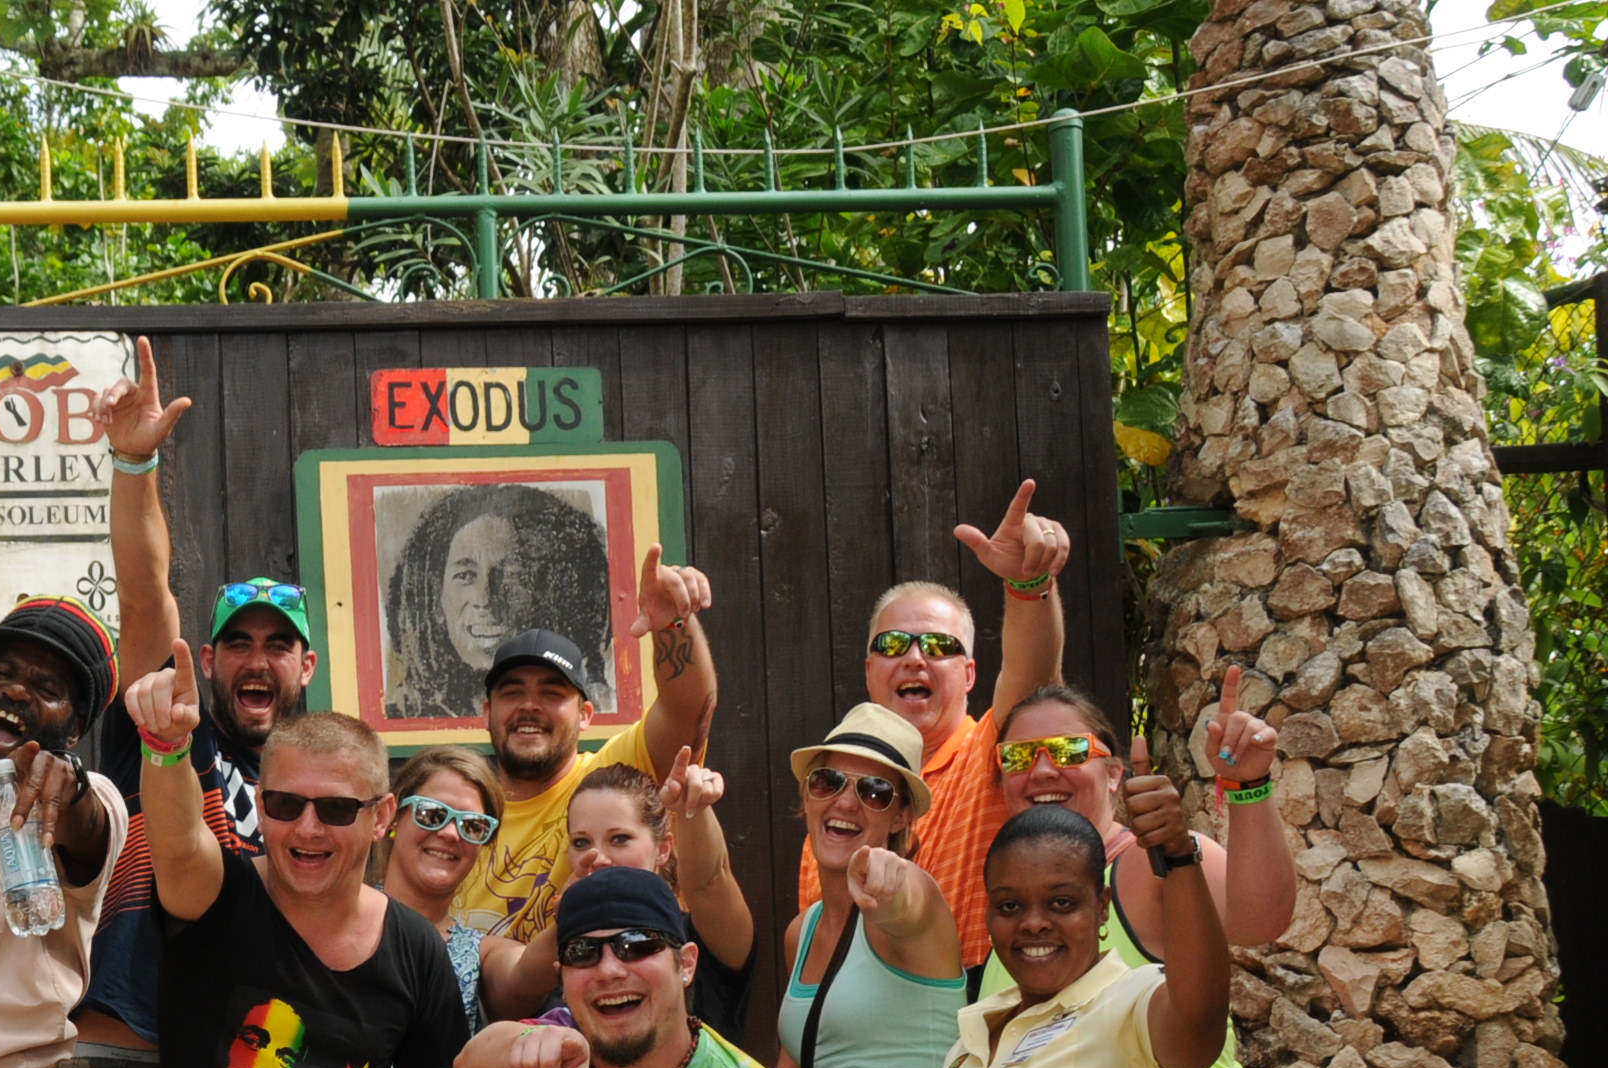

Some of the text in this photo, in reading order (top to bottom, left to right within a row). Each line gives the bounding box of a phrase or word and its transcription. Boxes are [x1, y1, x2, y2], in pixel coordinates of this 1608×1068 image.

[387, 377, 582, 432] EXODUS
[1233, 786, 1270, 801] TOUR
[0, 831, 17, 867] AQUA
